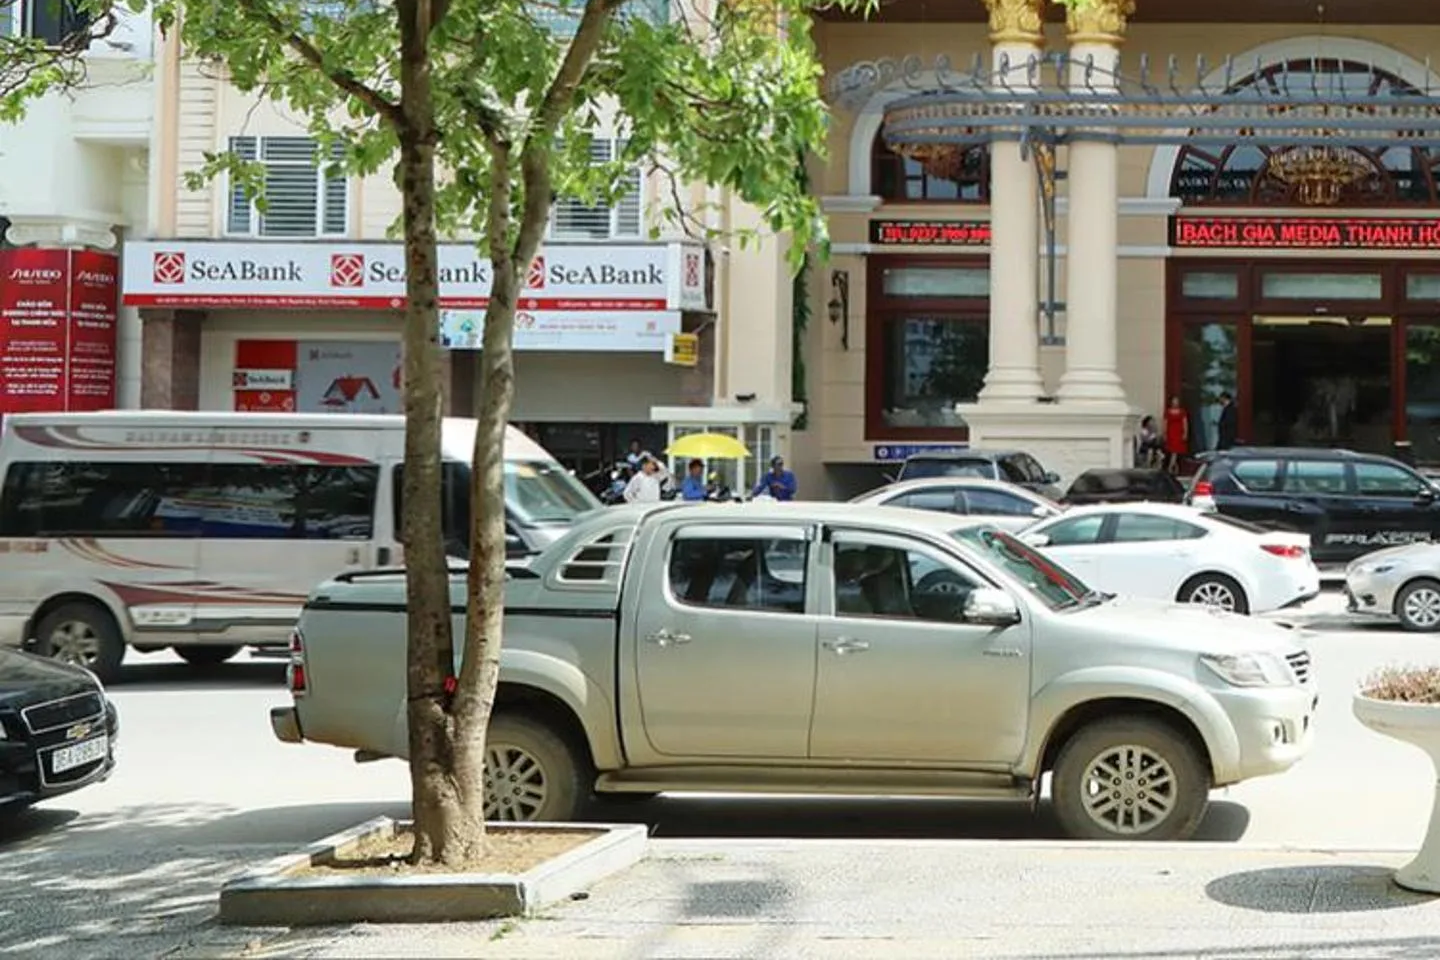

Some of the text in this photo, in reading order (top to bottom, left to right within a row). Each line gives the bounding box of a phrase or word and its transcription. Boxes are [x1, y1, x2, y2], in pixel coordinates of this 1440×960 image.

[1243, 224, 1275, 241] GIA
[1281, 224, 1341, 242] MEDIA
[1346, 225, 1413, 242] THANH
[190, 260, 303, 283] SeABank
[369, 262, 487, 284] Seank
[549, 263, 664, 285] SeABank
